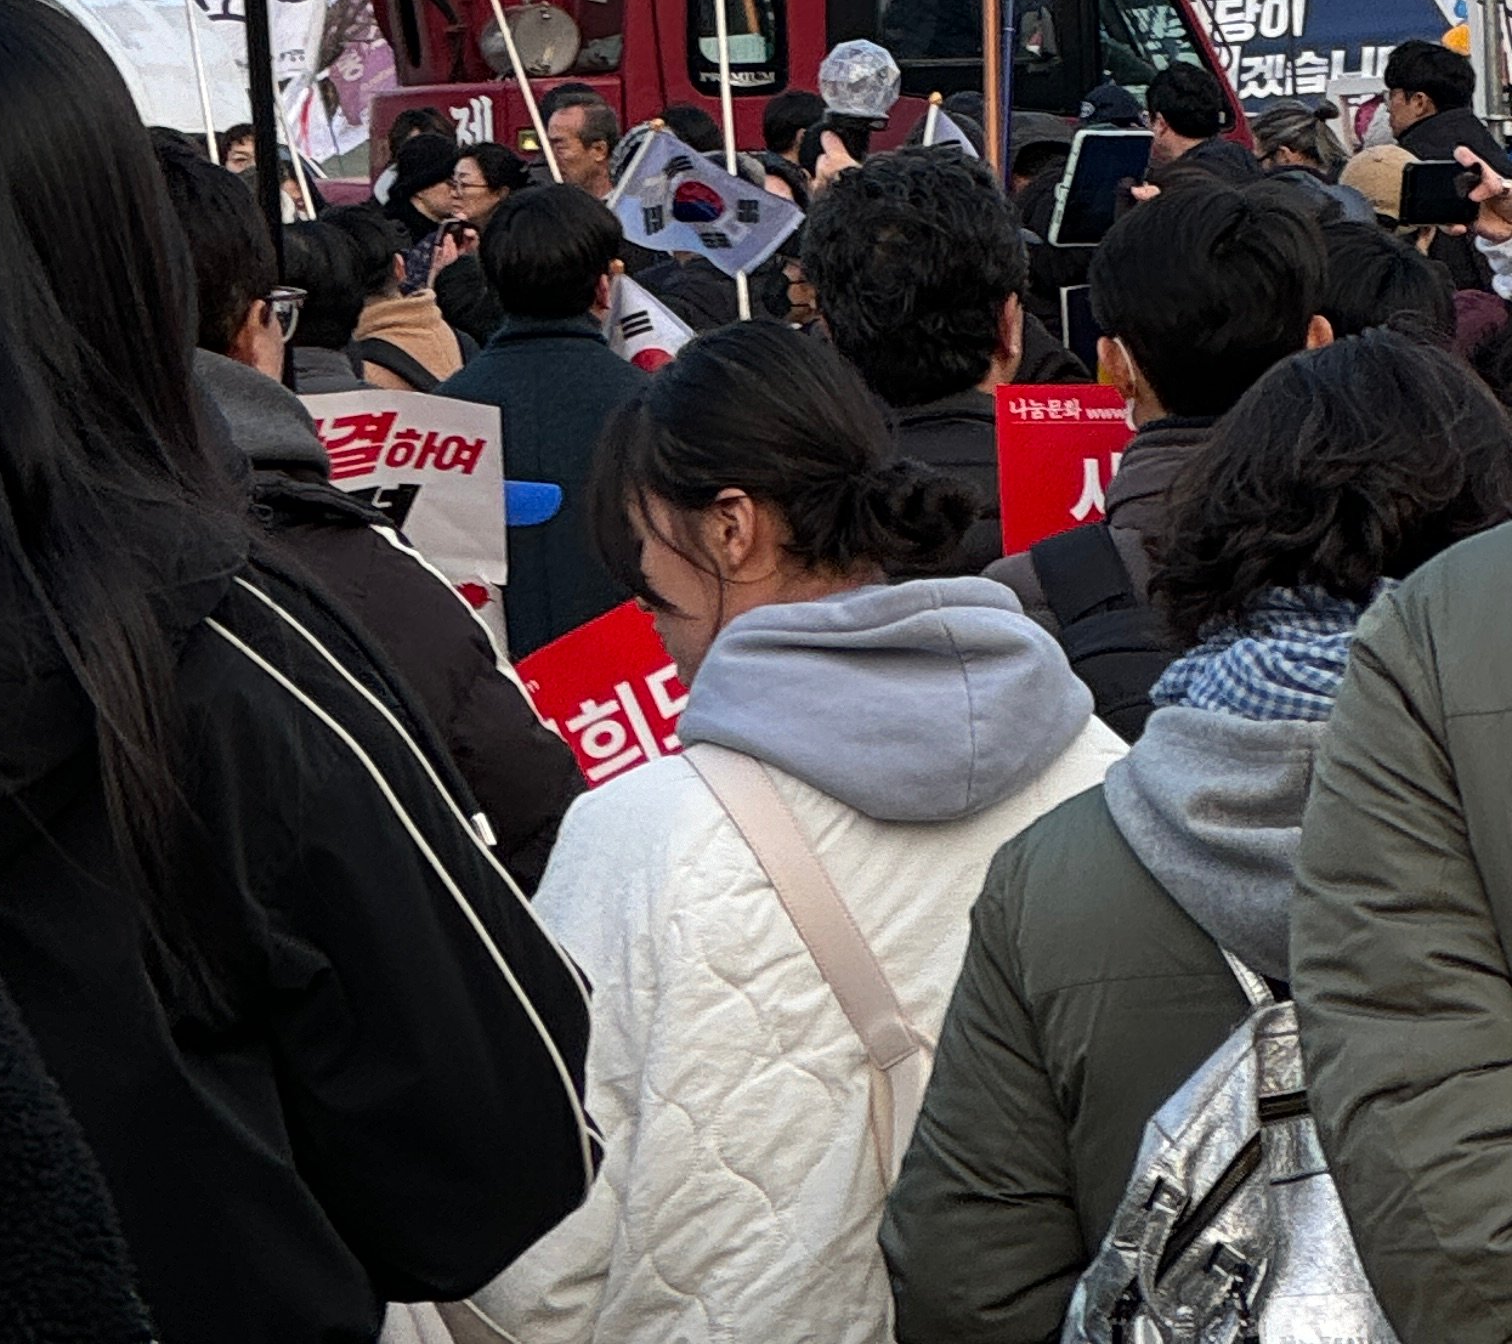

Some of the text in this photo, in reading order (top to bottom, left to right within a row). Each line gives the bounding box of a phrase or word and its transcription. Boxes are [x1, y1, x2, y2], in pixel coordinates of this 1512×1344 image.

[699, 71, 776, 84] PRMIUM
[1214, 45, 1397, 99] 겠습니
[1008, 397, 1083, 421] 나눔문화
